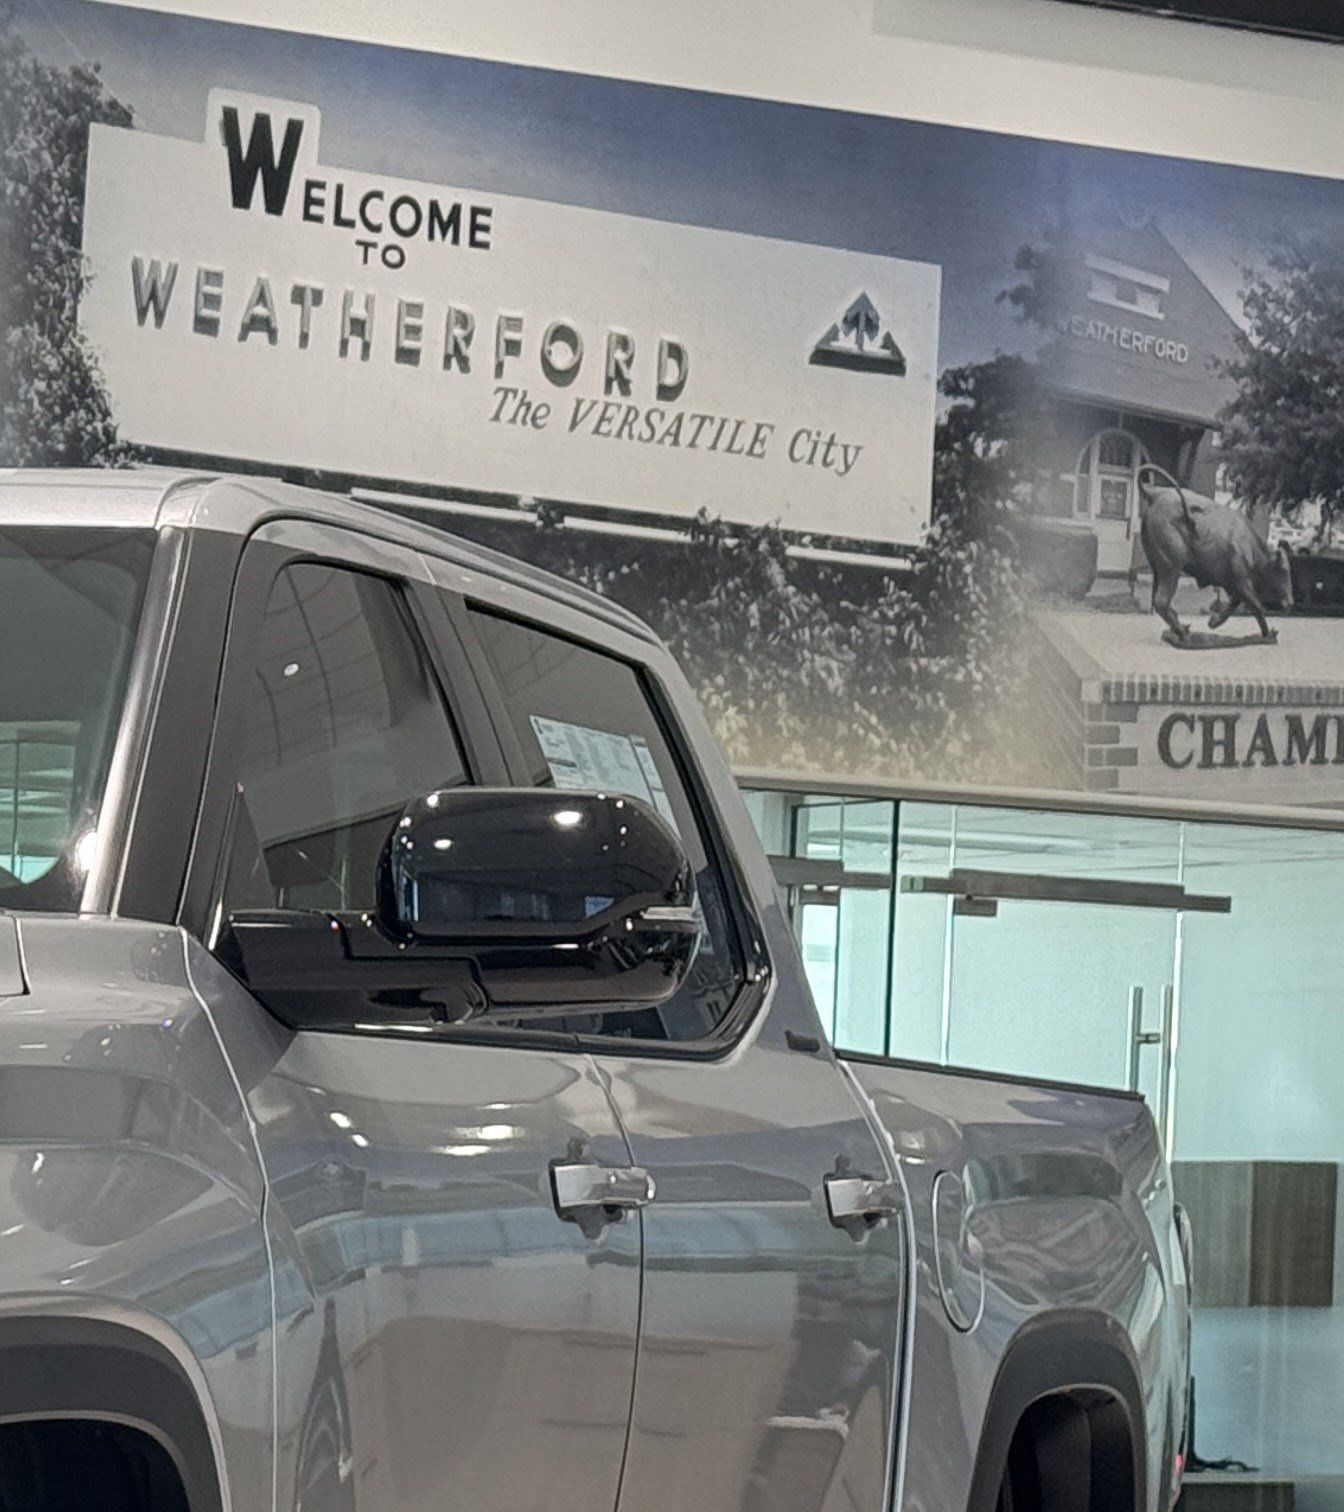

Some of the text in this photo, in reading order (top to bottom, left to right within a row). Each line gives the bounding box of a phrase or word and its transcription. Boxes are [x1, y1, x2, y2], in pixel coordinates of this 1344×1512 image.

[355, 239, 407, 270] TO
[129, 255, 691, 401] WEATHERFORD
[489, 386, 864, 477] The VERSATILE City
